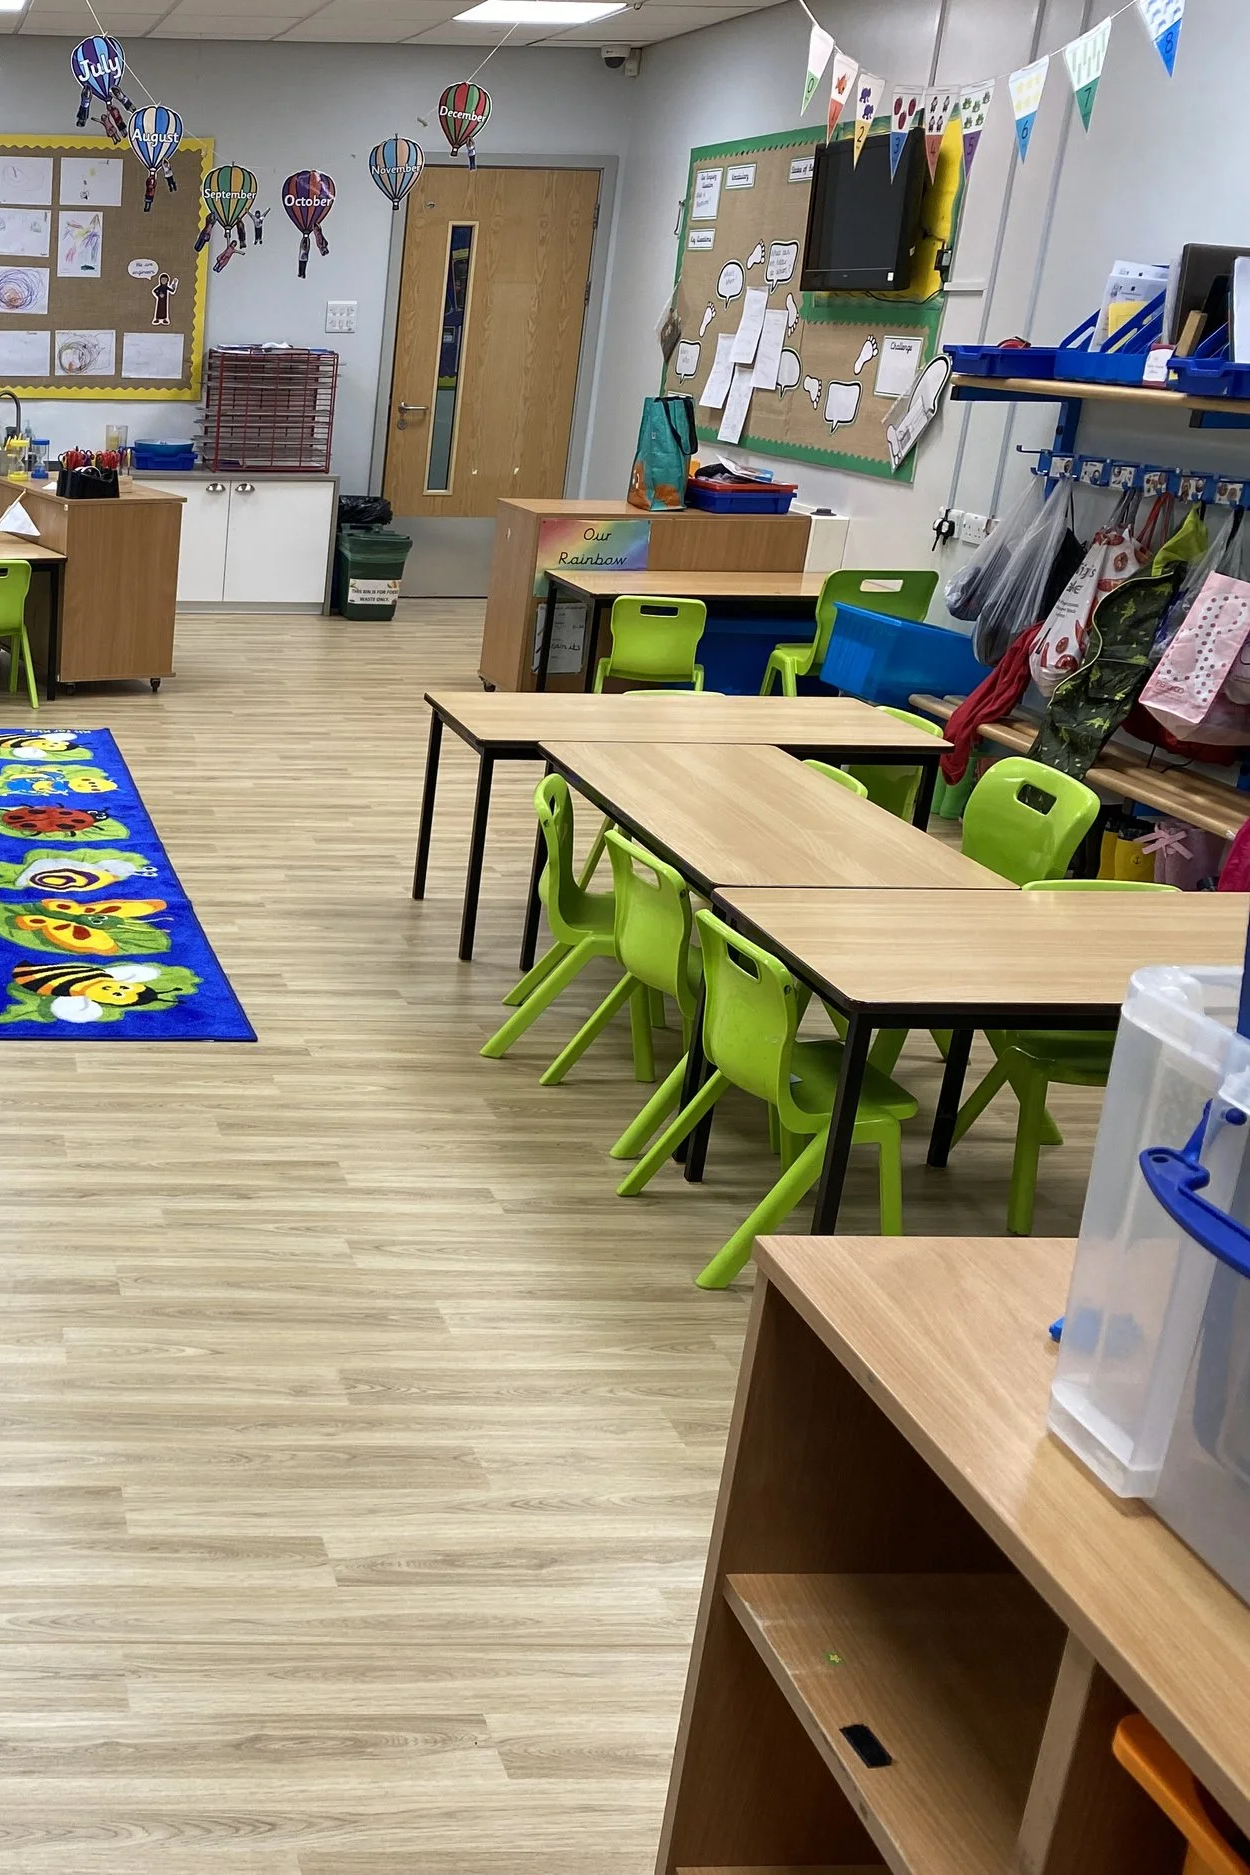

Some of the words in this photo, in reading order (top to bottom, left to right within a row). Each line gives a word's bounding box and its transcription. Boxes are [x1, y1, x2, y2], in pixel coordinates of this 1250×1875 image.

[1165, 31, 1174, 54] 8
[79, 57, 122, 82] July
[1085, 86, 1092, 109] 7
[439, 105, 487, 123] December
[131, 129, 179, 147] August
[857, 126, 865, 143] 2
[1021, 120, 1029, 140] 6
[893, 136, 901, 155] 3
[966, 137, 975, 156] 5
[371, 163, 422, 175] November
[203, 188, 257, 204] September
[284, 193, 333, 208] October
[890, 341, 913, 354] Challenge
[583, 527, 612, 541] Our
[558, 552, 627, 566] Rainbow
